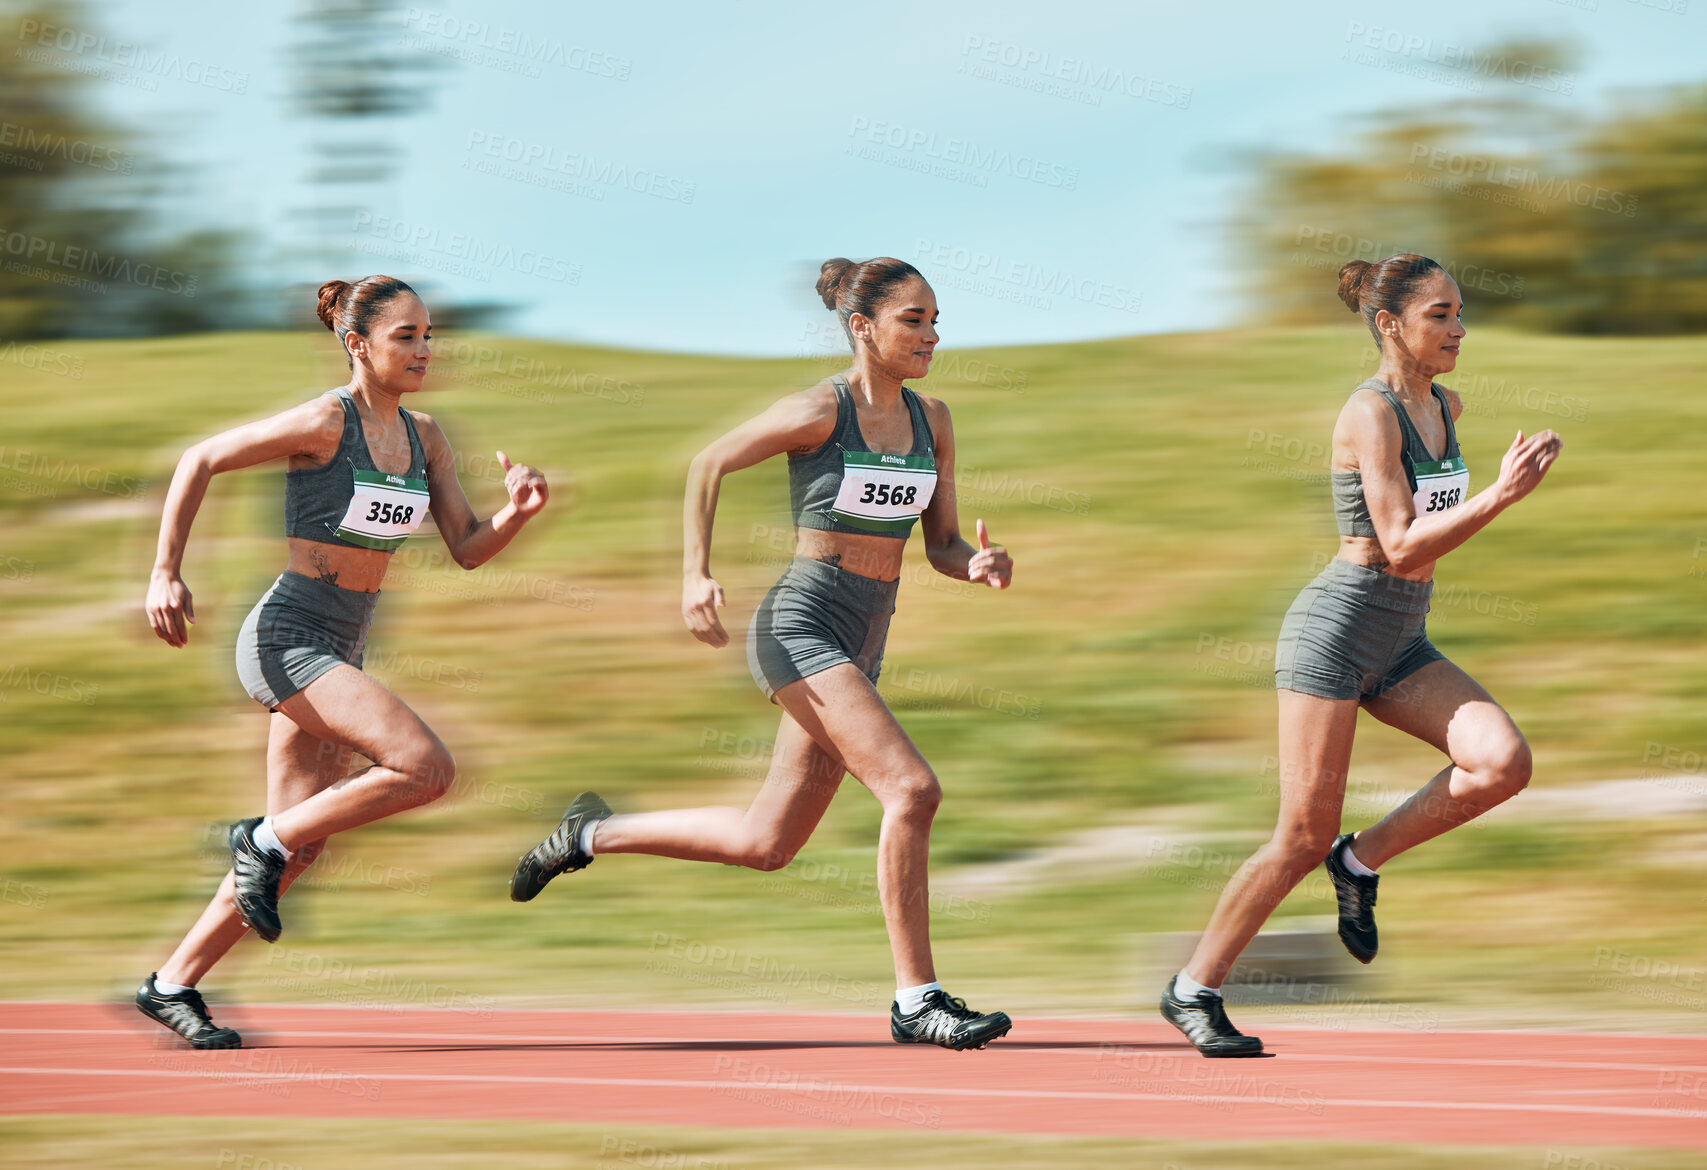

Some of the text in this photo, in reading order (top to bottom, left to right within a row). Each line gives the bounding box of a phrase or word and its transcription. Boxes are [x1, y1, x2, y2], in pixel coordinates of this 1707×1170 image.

[880, 455, 906, 465] Athlete
[859, 483, 917, 506] 3568
[1426, 487, 1460, 512] 3568
[365, 501, 414, 525] 3568
